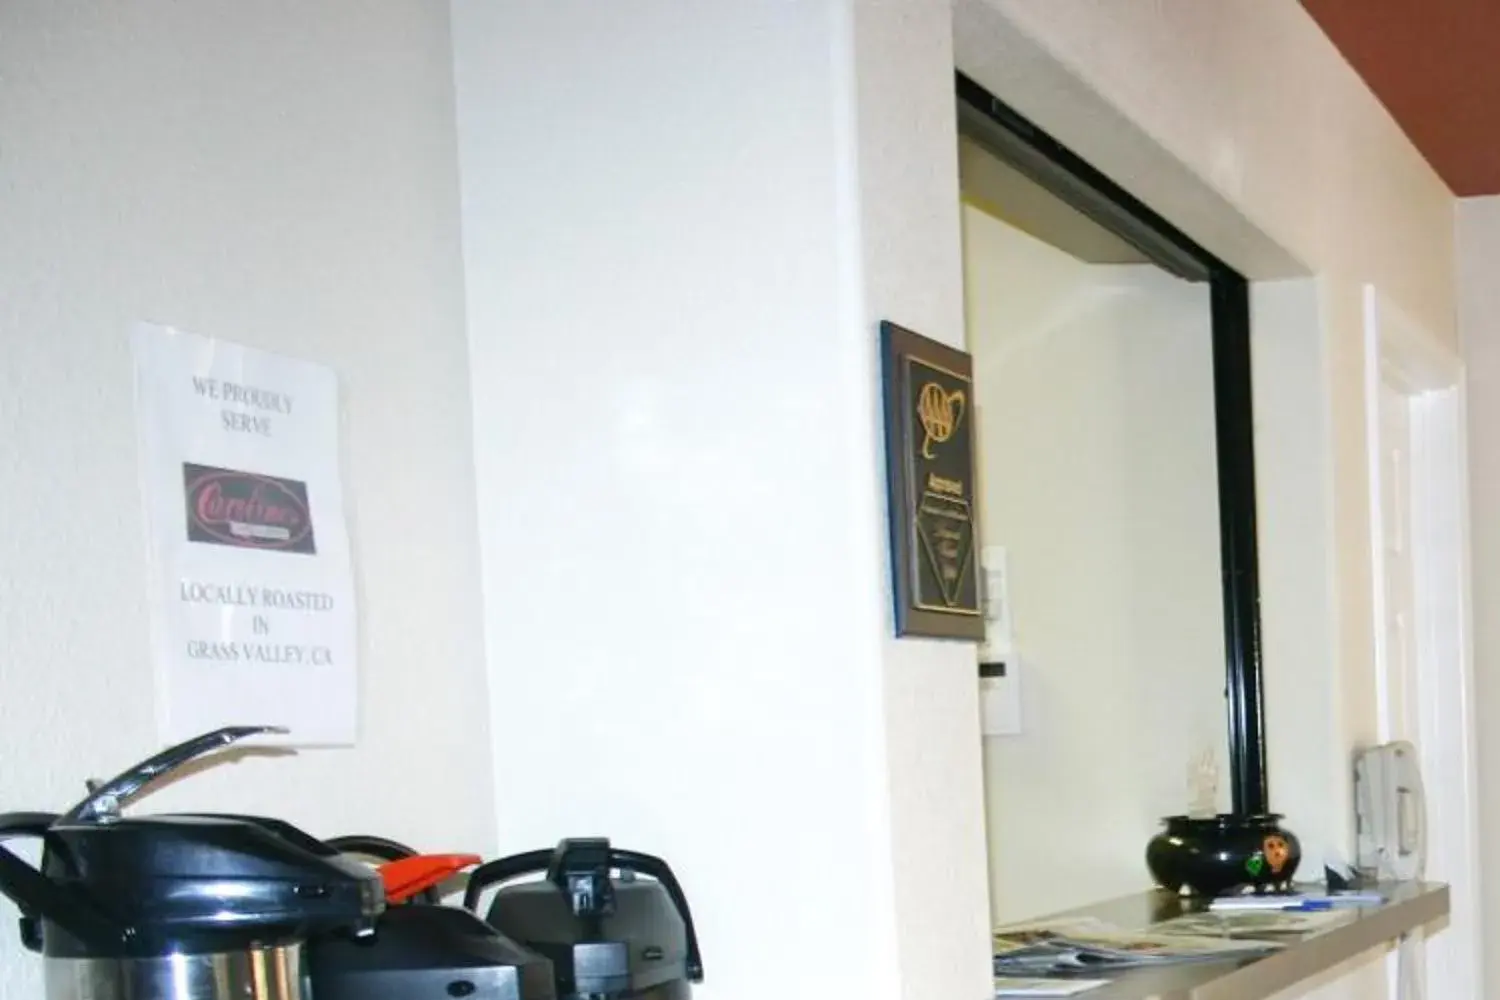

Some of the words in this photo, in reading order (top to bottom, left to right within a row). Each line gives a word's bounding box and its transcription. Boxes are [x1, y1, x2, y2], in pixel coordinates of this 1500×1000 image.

[192, 375, 219, 399] WE
[222, 381, 294, 414] PROUDLY
[221, 409, 272, 437] SERVE
[180, 580, 258, 606] LOCALLY
[261, 586, 334, 612] ROASTED
[252, 613, 269, 636] IN
[186, 639, 239, 661] GRASS
[311, 645, 333, 666] CA
